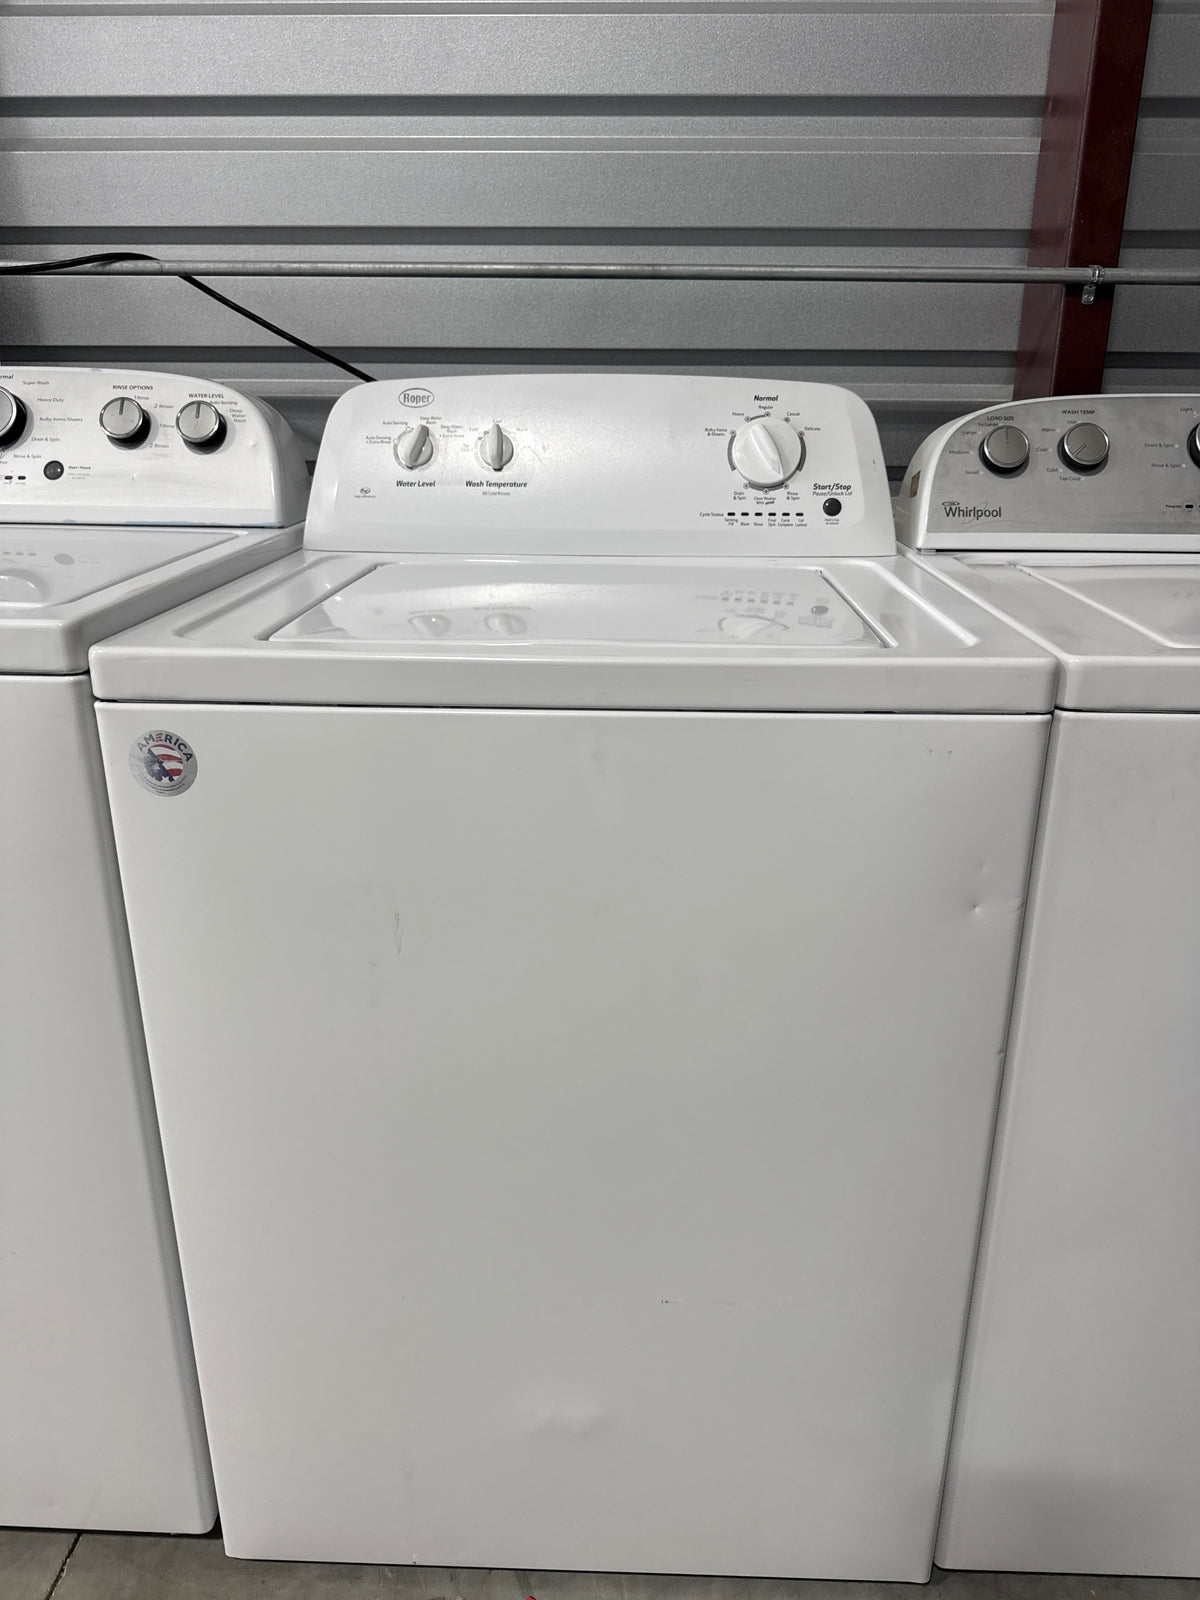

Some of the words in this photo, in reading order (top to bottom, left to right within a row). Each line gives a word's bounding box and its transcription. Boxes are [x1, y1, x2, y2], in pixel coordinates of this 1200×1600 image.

[403, 393, 431, 405] Roper
[396, 480, 416, 488] Water
[417, 480, 436, 488] Level
[465, 480, 484, 488] Wash
[485, 480, 528, 490] Temperature
[813, 483, 852, 492] Start/Stop
[943, 506, 1002, 521] Whirlpool
[137, 733, 193, 762] AMERICA
